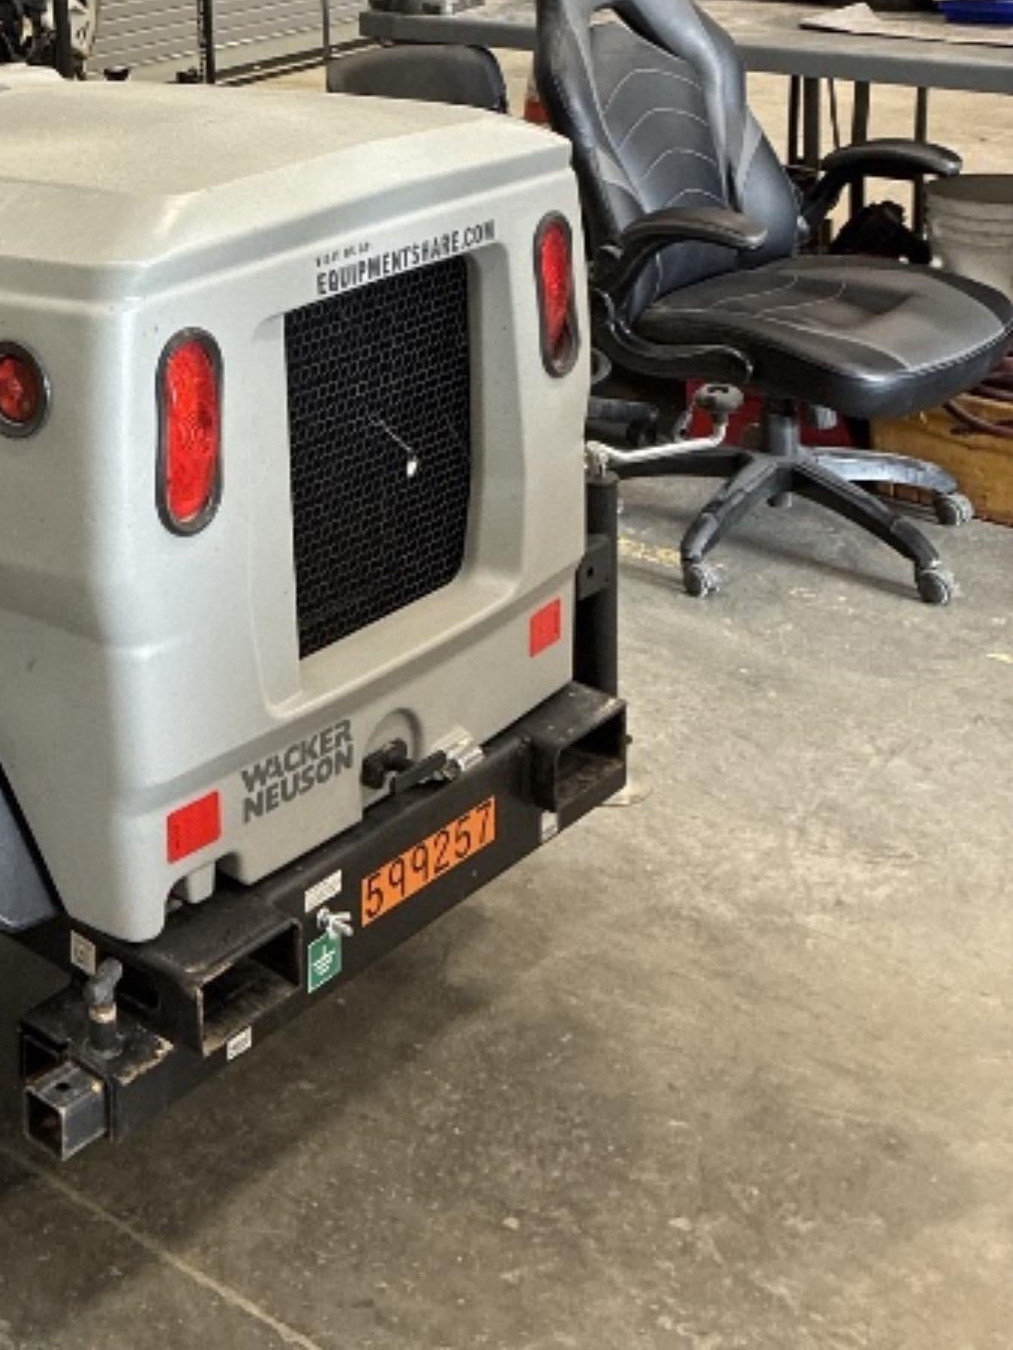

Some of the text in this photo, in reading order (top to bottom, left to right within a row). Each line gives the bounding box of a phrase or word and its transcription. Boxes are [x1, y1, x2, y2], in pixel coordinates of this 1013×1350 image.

[316, 218, 495, 296] EQUIPMENTSHARE.COM
[241, 718, 353, 794] WACKER
[243, 742, 354, 824] NEUSON
[366, 800, 495, 918] 599257
